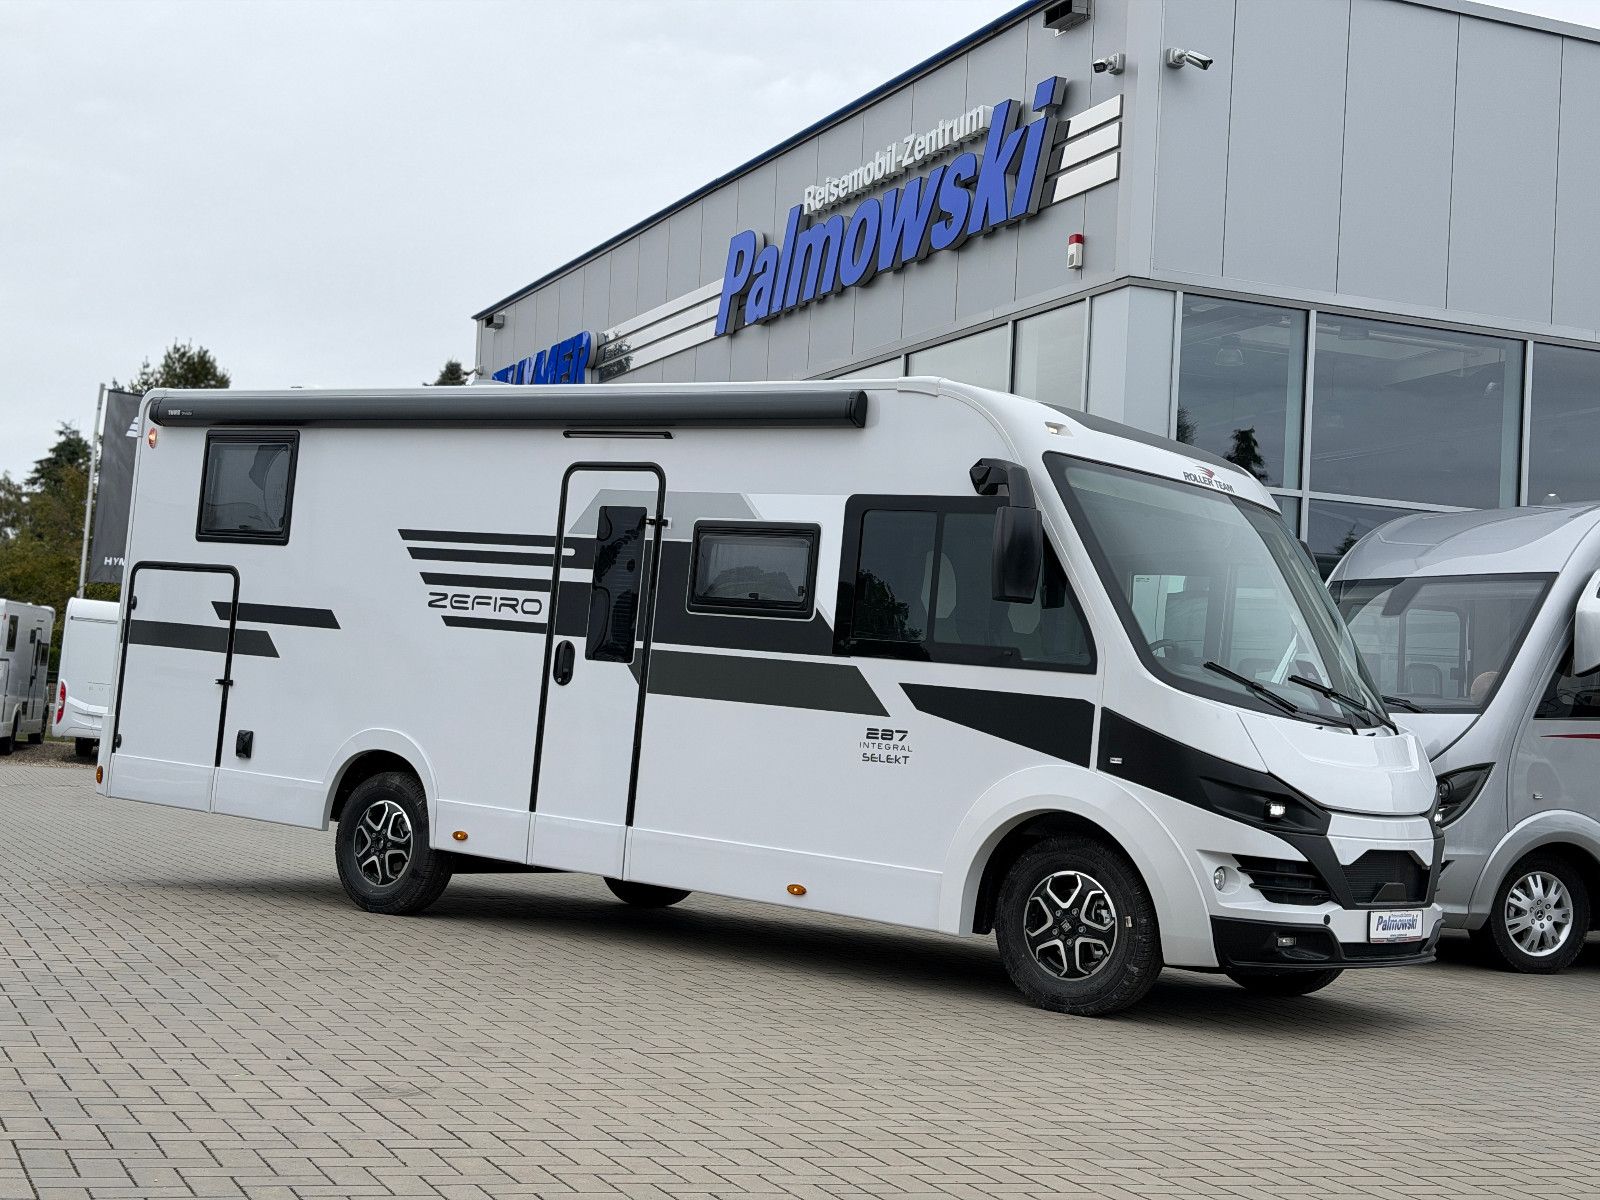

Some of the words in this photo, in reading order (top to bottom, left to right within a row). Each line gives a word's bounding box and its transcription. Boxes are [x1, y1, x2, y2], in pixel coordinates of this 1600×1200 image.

[803, 104, 990, 215] Reisemobil-Zentrum
[714, 76, 1066, 337] Palmowski
[1183, 471, 1214, 487] ROLLER
[1214, 480, 1235, 493] TEAM
[427, 592, 543, 615] ZEFIRO
[866, 727, 908, 742] 287
[859, 741, 913, 752] INTEGRAL
[862, 752, 910, 765] SELEKT
[1376, 914, 1418, 931] Palmowski
